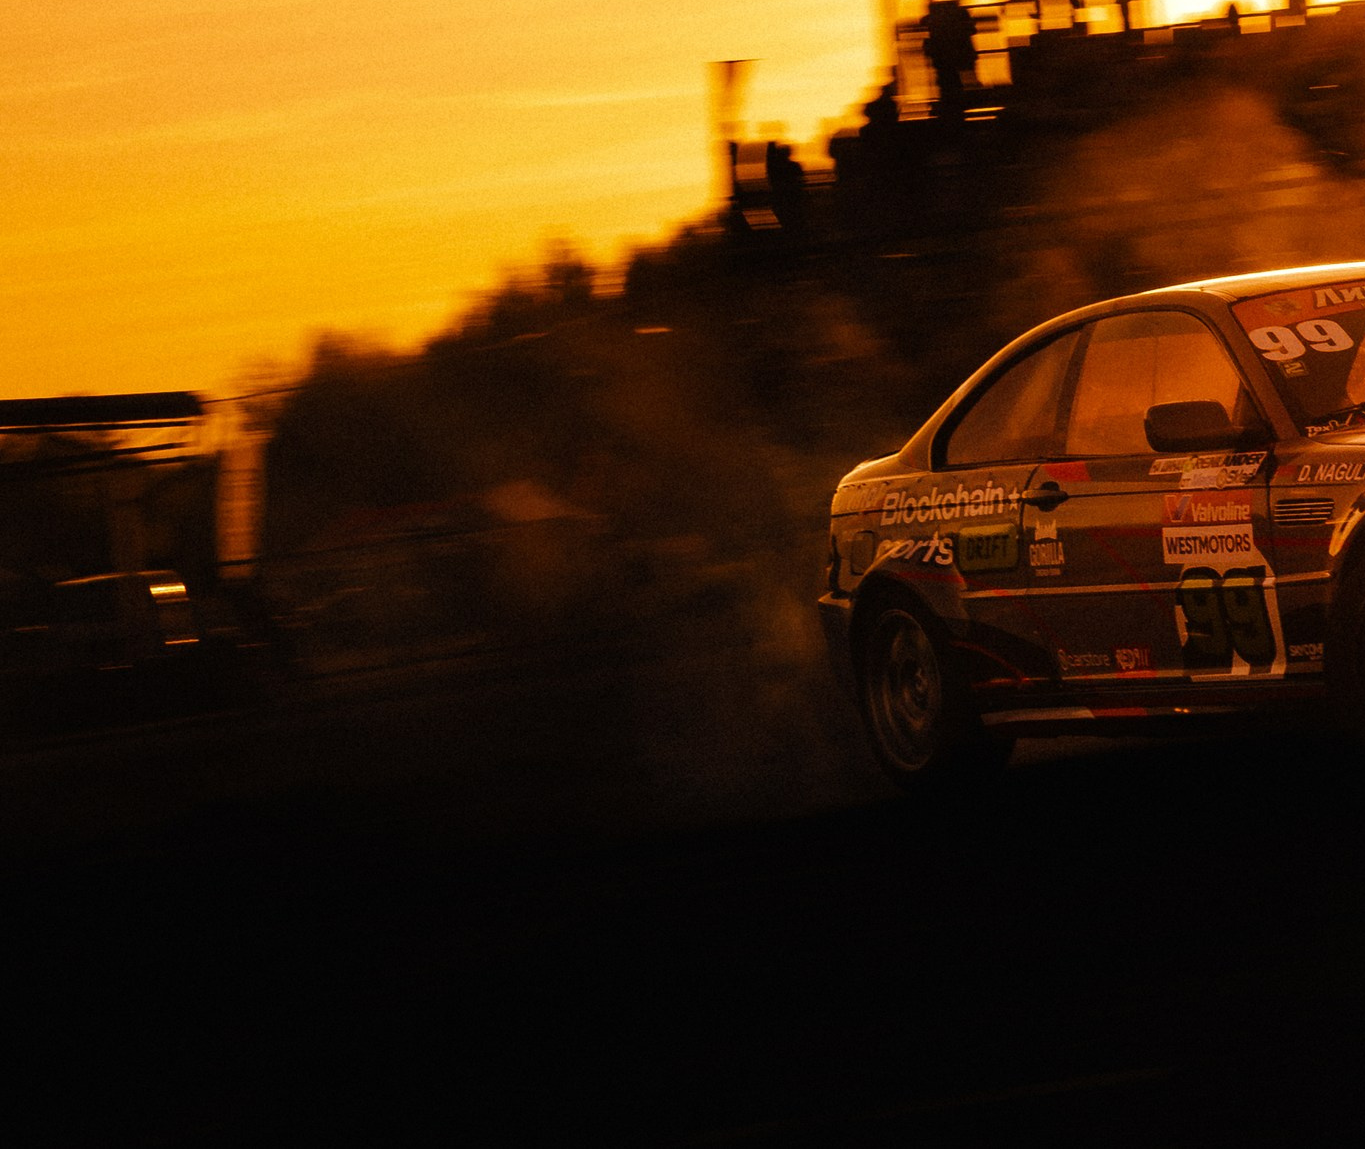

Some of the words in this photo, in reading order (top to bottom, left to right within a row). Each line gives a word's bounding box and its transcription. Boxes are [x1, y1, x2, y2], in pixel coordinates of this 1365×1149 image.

[1249, 319, 1354, 360] 99
[1297, 464, 1311, 481] D.
[880, 480, 1004, 526] Blockchain
[1191, 501, 1250, 523] Valvoline
[1165, 533, 1252, 555] WESTMOTORS
[1179, 567, 1275, 664] 99
